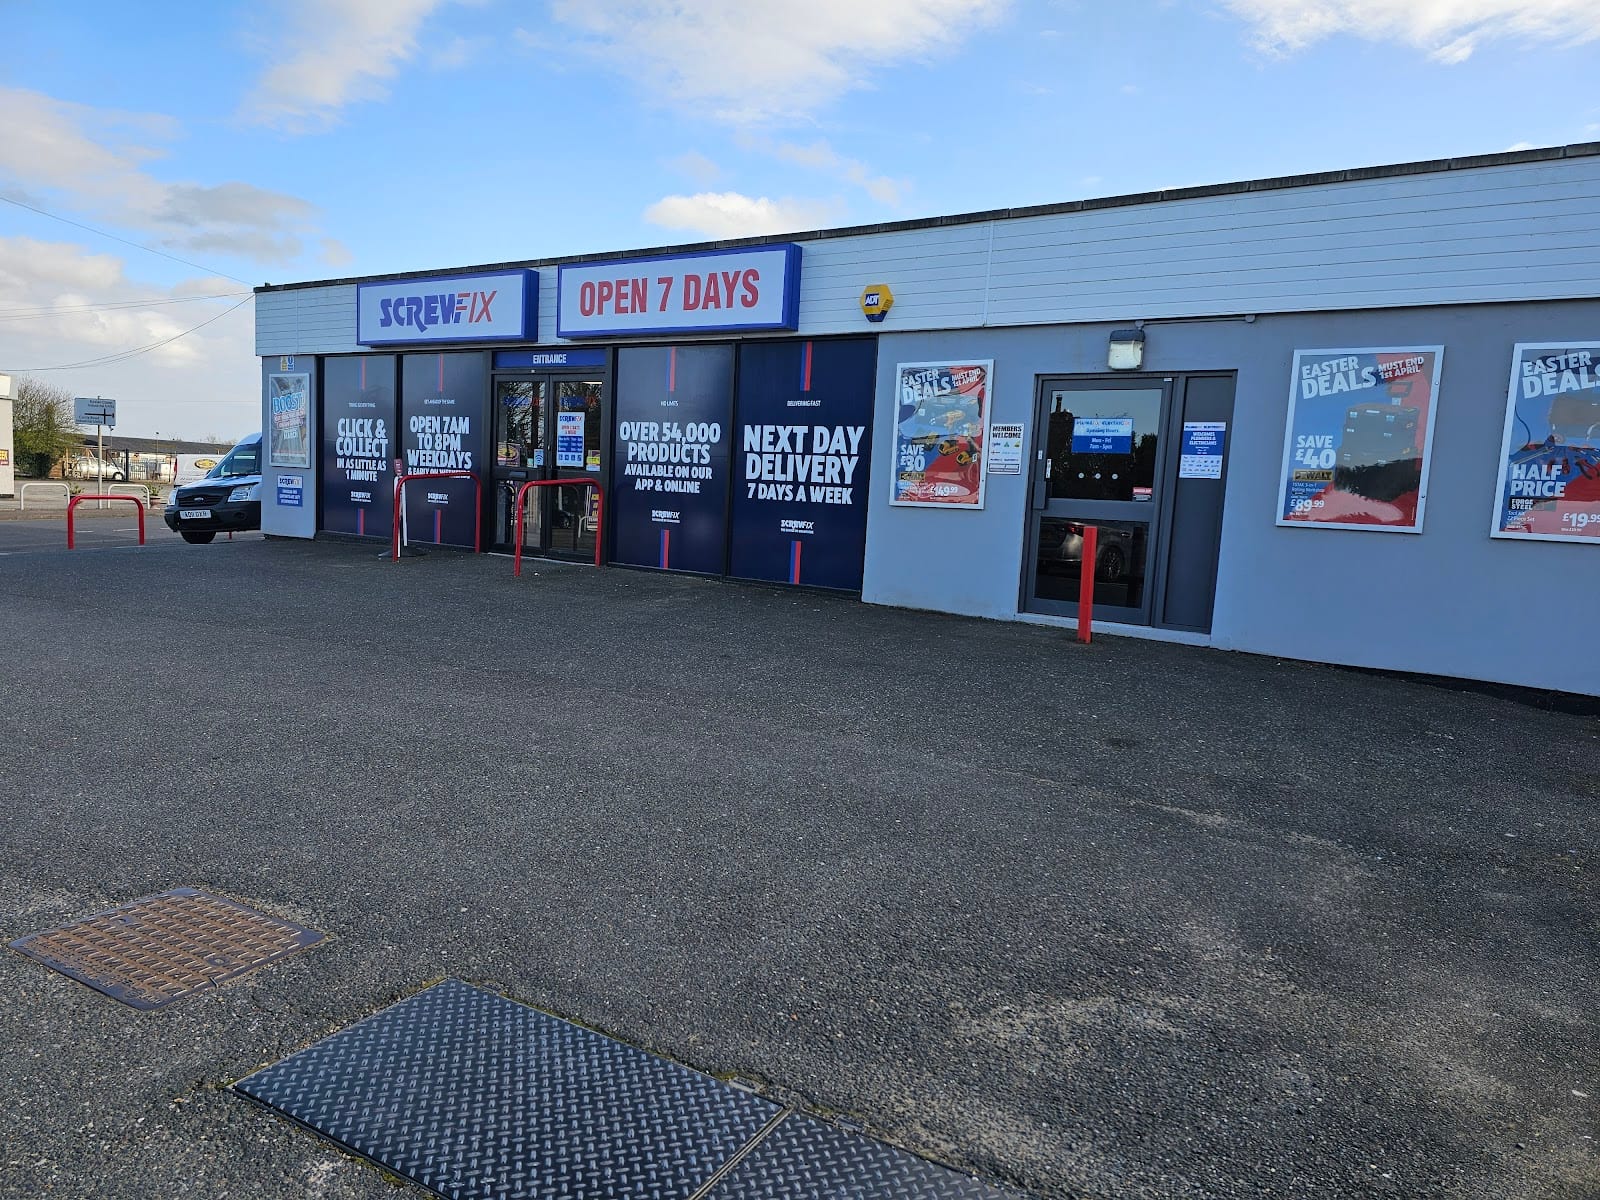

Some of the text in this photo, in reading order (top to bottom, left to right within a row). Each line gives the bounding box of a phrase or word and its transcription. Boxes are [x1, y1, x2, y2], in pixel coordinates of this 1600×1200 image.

[580, 268, 760, 317] OPEN 7 DAYS
[864, 294, 880, 305] ADT
[379, 290, 498, 333] SCREWFIX
[533, 354, 567, 364] ENTRANCE
[1301, 356, 1360, 380] EASTER
[1378, 356, 1424, 372] MUST END
[1522, 351, 1592, 377] EASTER
[902, 369, 940, 388] EASTER
[1394, 365, 1421, 378] APRIL
[902, 376, 952, 404] DEALS
[1301, 366, 1377, 399] DEALS
[337, 417, 387, 439] CLICK &
[410, 415, 470, 434] OPEN 7AM
[619, 421, 721, 445] OVER 54,000
[335, 437, 388, 458] COLLECT
[416, 433, 461, 451] TO 8PM
[743, 424, 866, 455] NEXT DAY
[1295, 435, 1334, 449] SAVE
[407, 449, 472, 470] WEEKDAYS
[627, 442, 711, 464] PRODUCTS
[900, 444, 925, 456] SAVE
[1294, 448, 1337, 469] £40
[336, 457, 345, 469] IN
[345, 458, 355, 469] AS
[355, 458, 377, 471] LITTLE
[377, 460, 387, 471] AS
[624, 463, 713, 480] AVAILABLE ON OUR
[745, 453, 859, 485] DELIVERY
[900, 455, 926, 472] £30
[1512, 463, 1563, 481] HALF
[345, 469, 378, 482] 1 MINUTE
[634, 478, 700, 494] APP & ONLINE
[747, 483, 853, 505] 7 DAYS A WEEK
[1510, 480, 1567, 498] PRICE
[1290, 498, 1325, 512] £89.99
